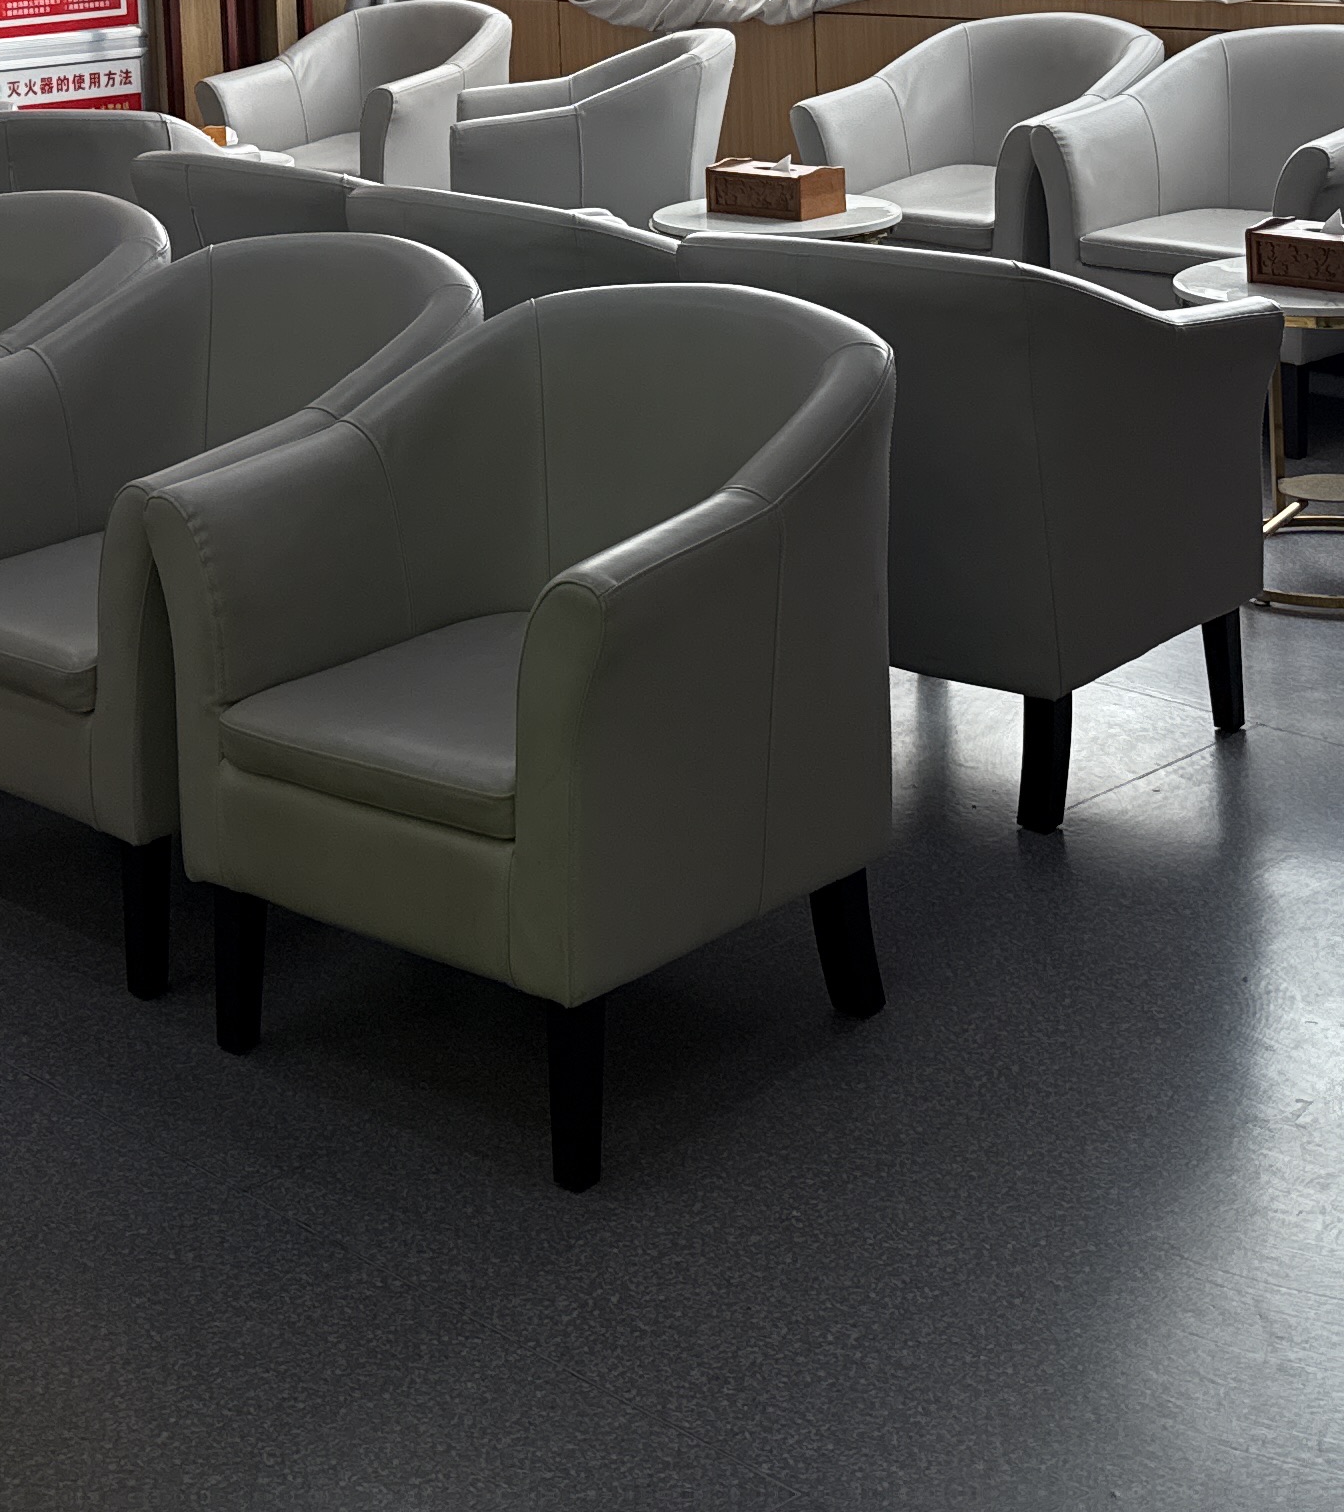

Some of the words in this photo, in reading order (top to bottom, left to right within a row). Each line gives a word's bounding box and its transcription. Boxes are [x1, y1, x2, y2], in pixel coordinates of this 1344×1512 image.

[7, 68, 133, 98] 灭火器的使用方法
